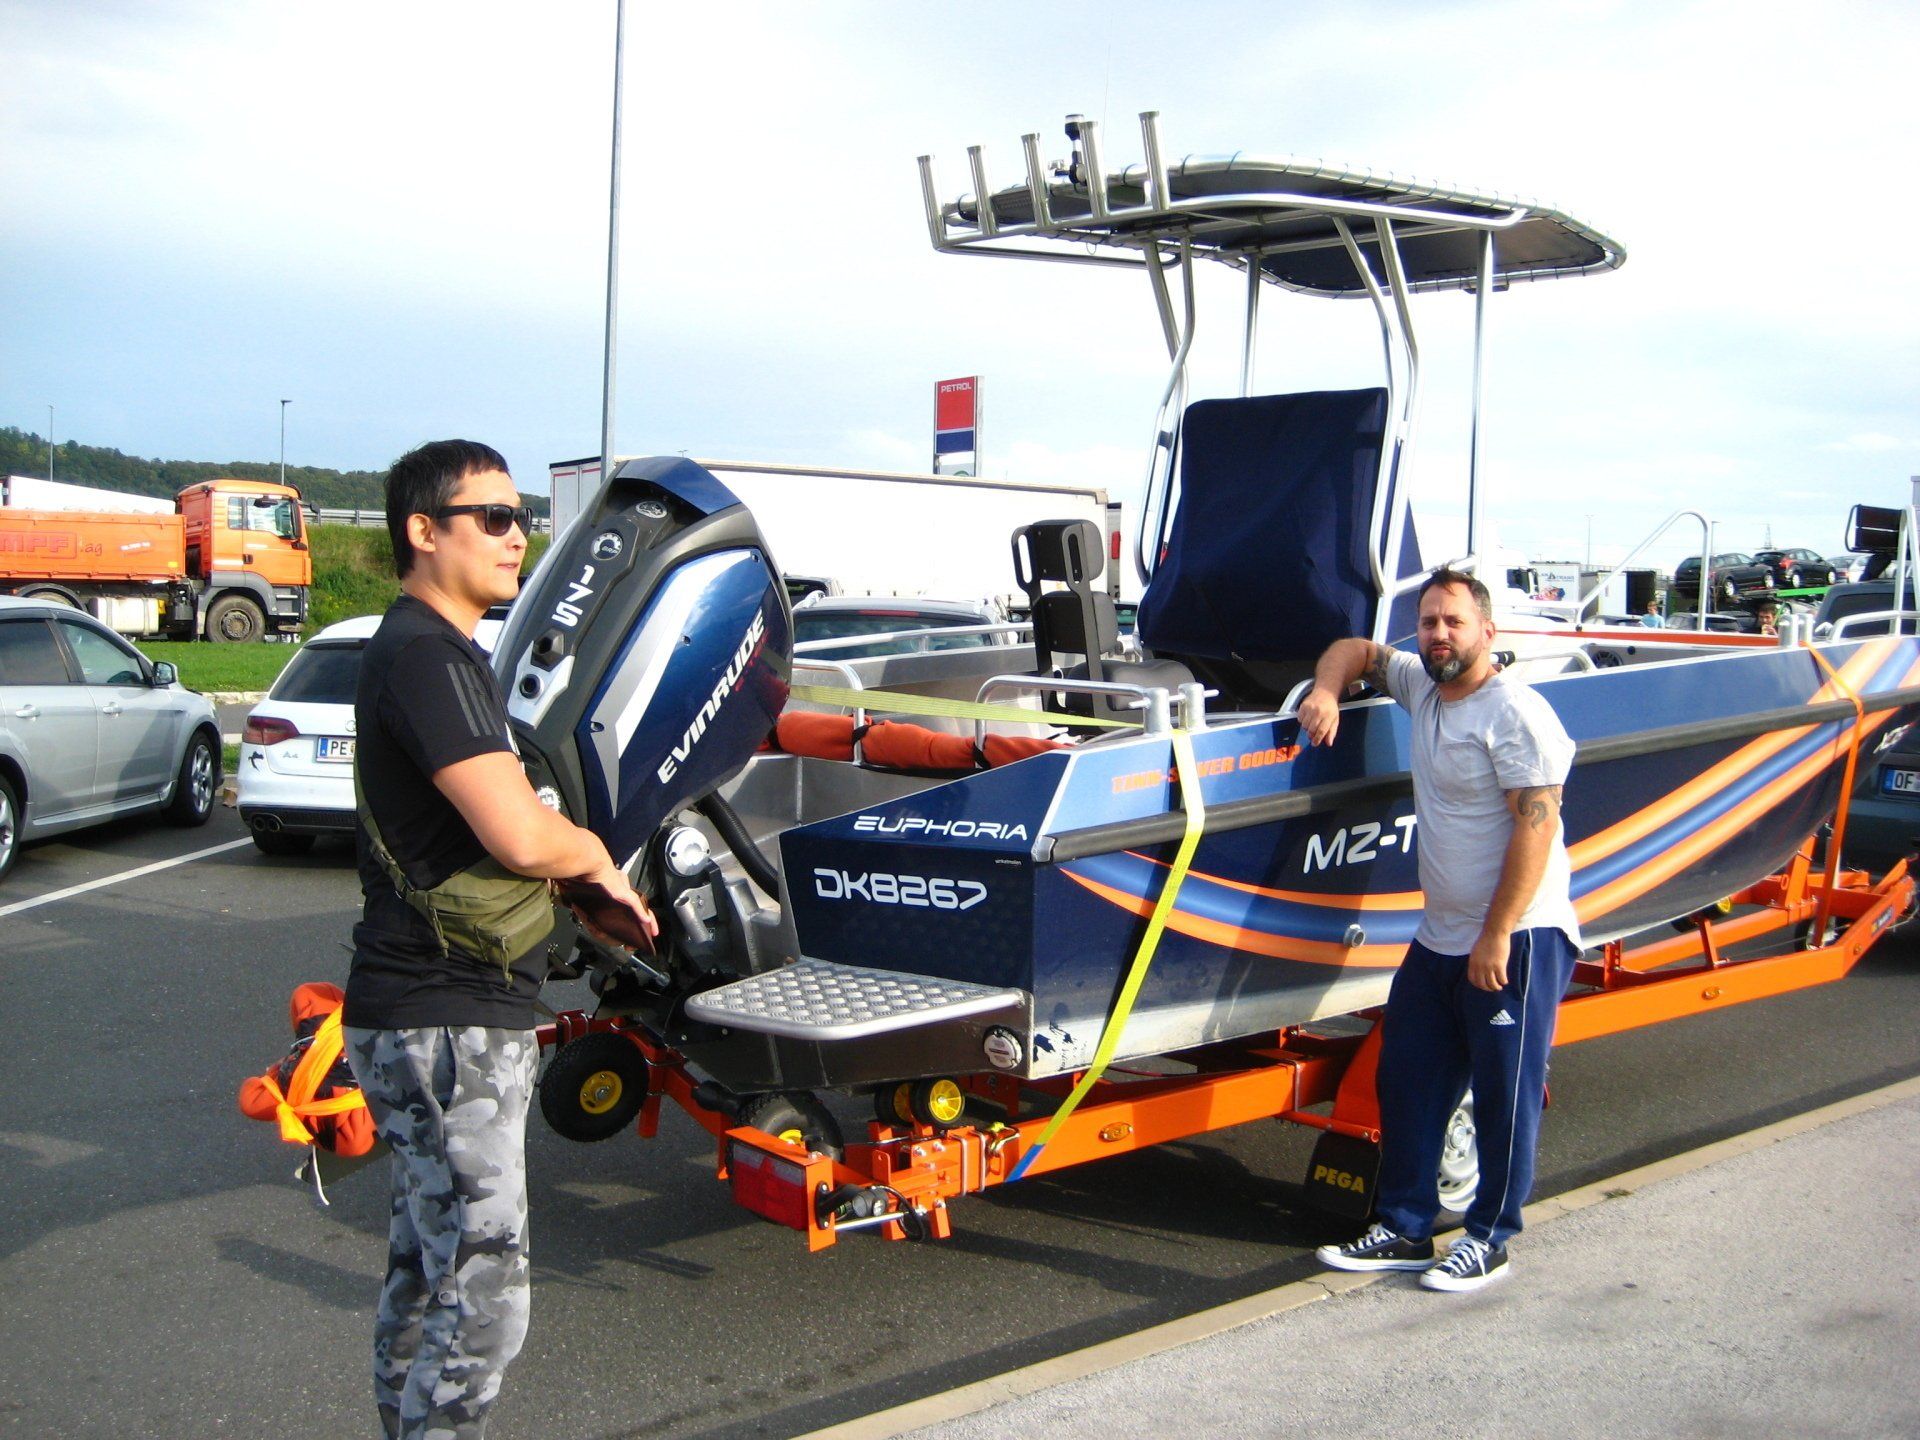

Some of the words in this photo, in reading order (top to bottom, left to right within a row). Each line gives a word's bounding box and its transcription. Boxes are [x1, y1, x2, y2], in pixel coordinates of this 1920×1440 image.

[940, 382, 972, 393] PETROL
[551, 564, 596, 627] 175
[656, 607, 765, 785] EVINRUDE
[330, 741, 348, 755] PE
[1894, 772, 1915, 789] OF
[853, 815, 1029, 841] EUPHORIA
[813, 867, 988, 911] DK8267
[1313, 1164, 1365, 1194] PEGA
